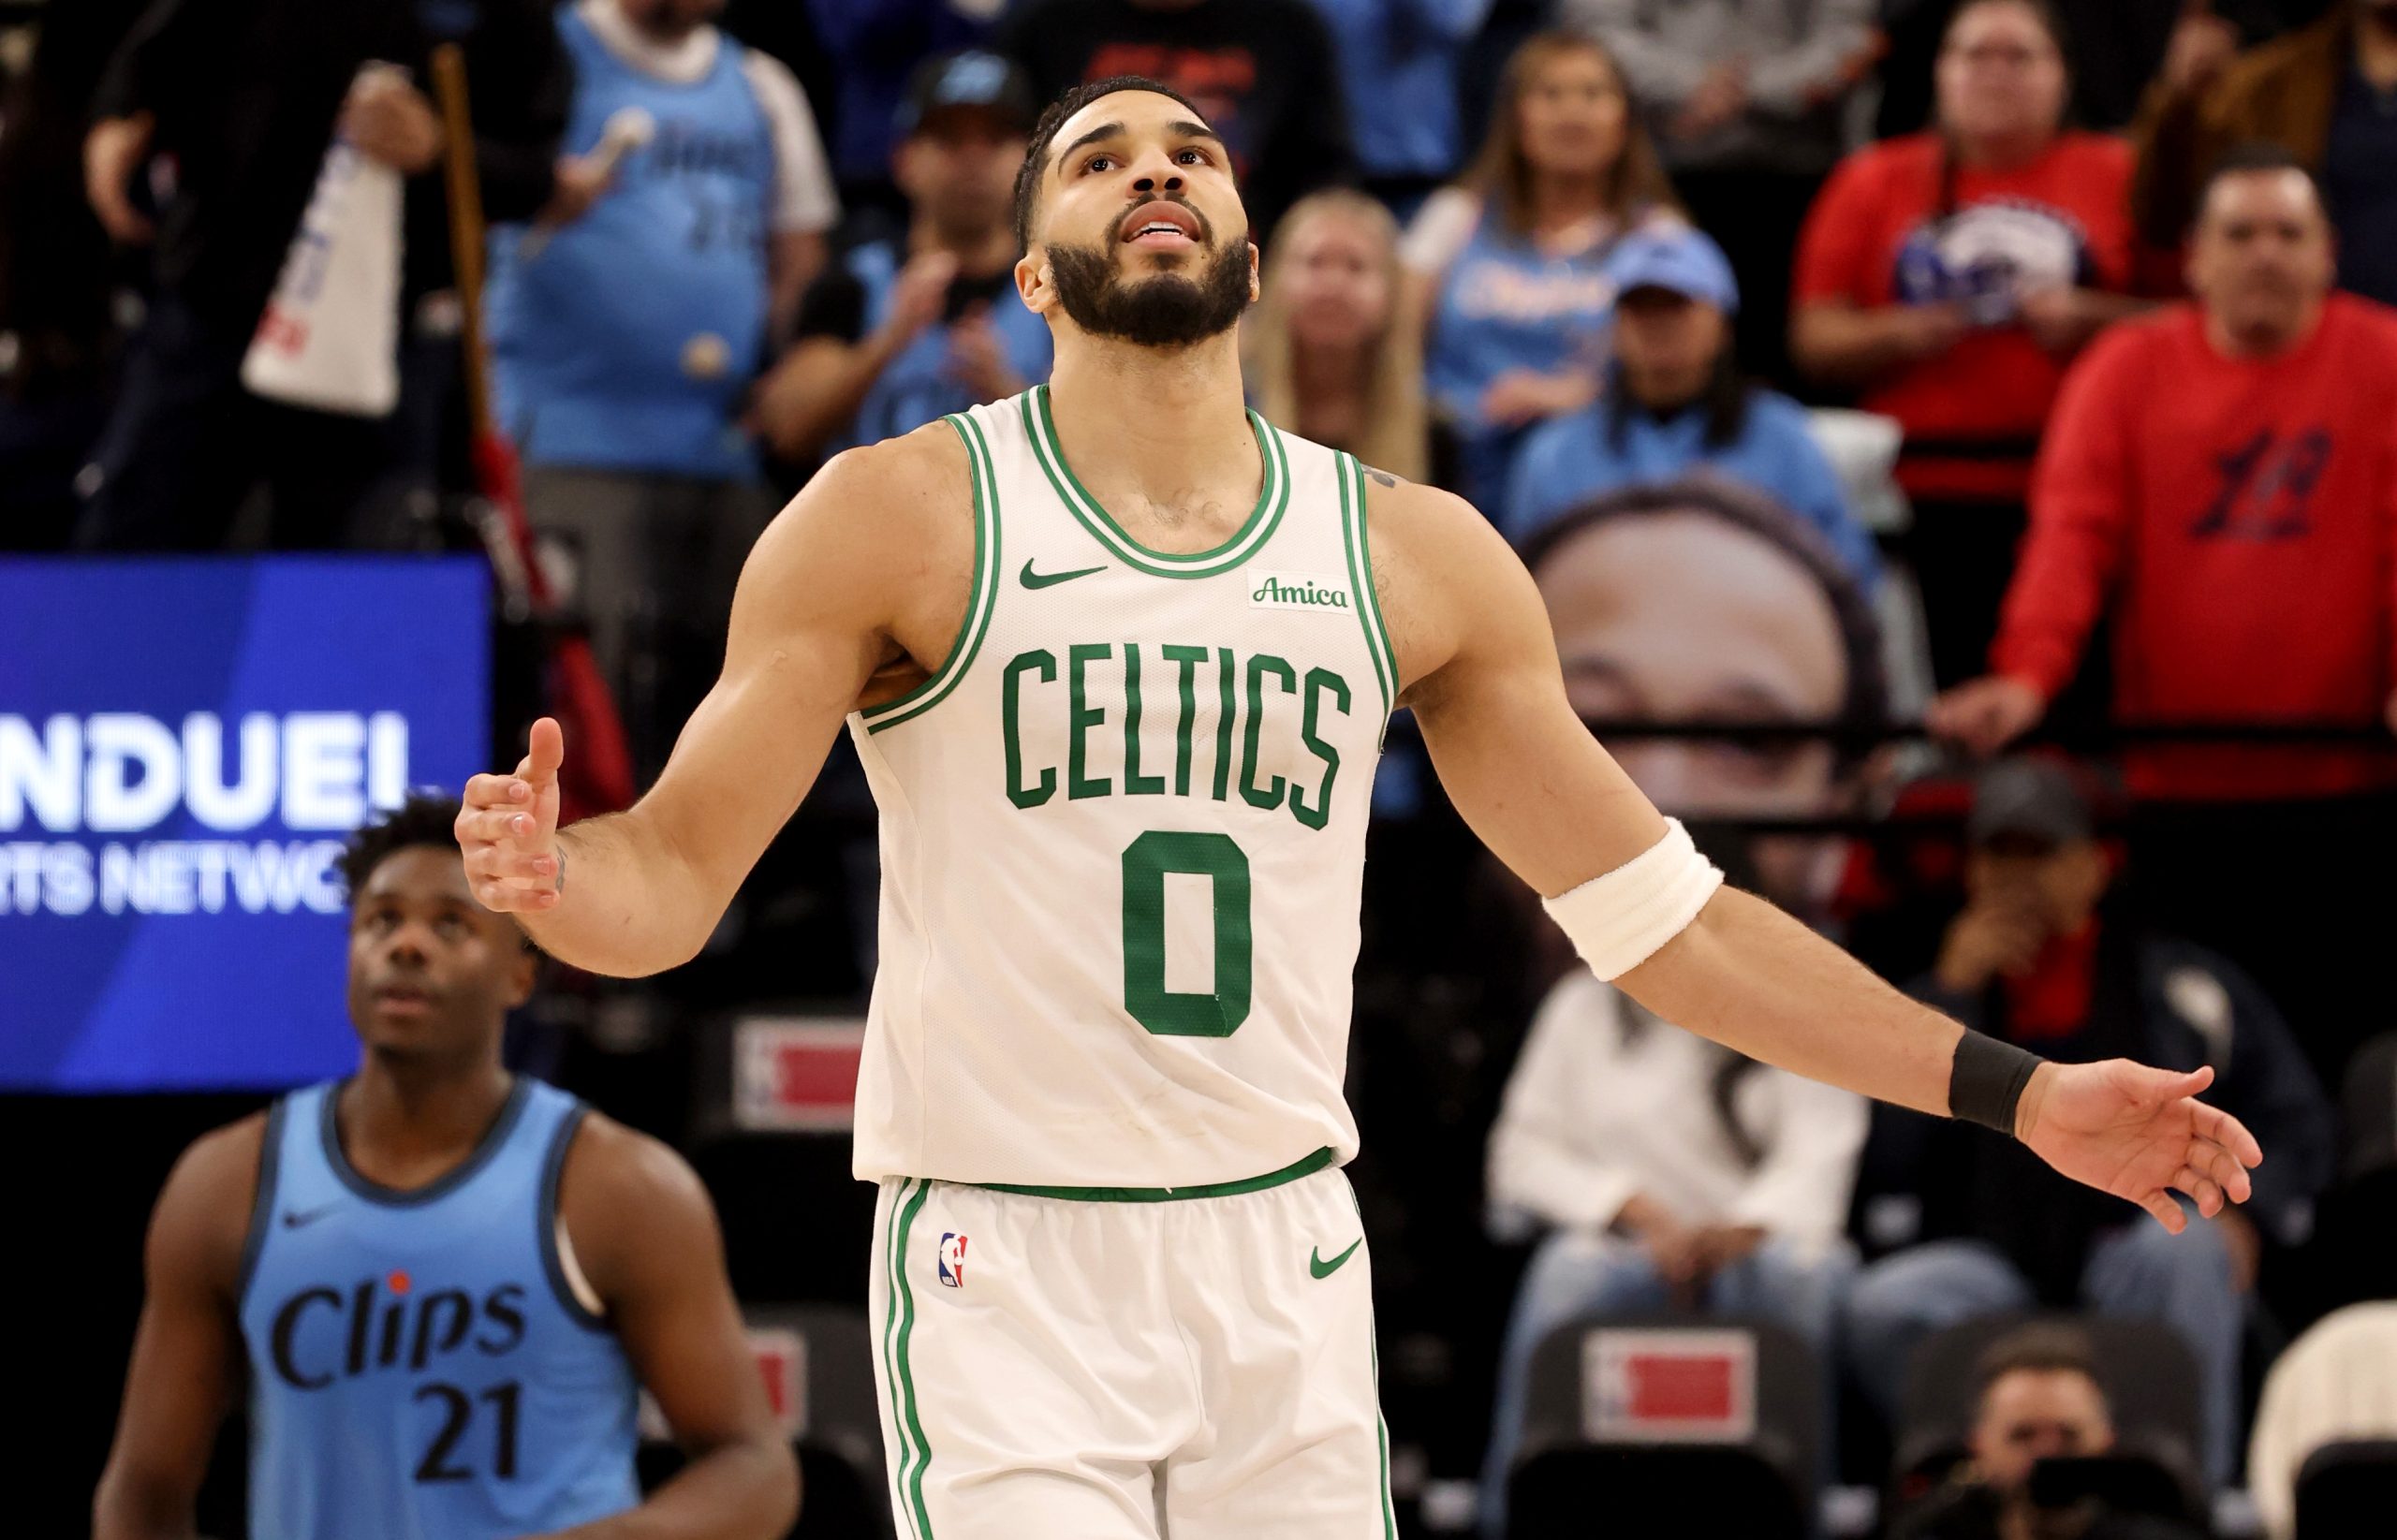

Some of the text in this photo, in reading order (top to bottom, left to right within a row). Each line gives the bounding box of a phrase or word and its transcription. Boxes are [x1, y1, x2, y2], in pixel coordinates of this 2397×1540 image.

[1252, 577, 1348, 608] Amica
[1002, 643, 1351, 831] CELTICS
[0, 841, 96, 917] TS
[1122, 830, 1252, 1038] 0
[271, 1269, 527, 1391] Clips
[415, 1381, 521, 1484] 21
